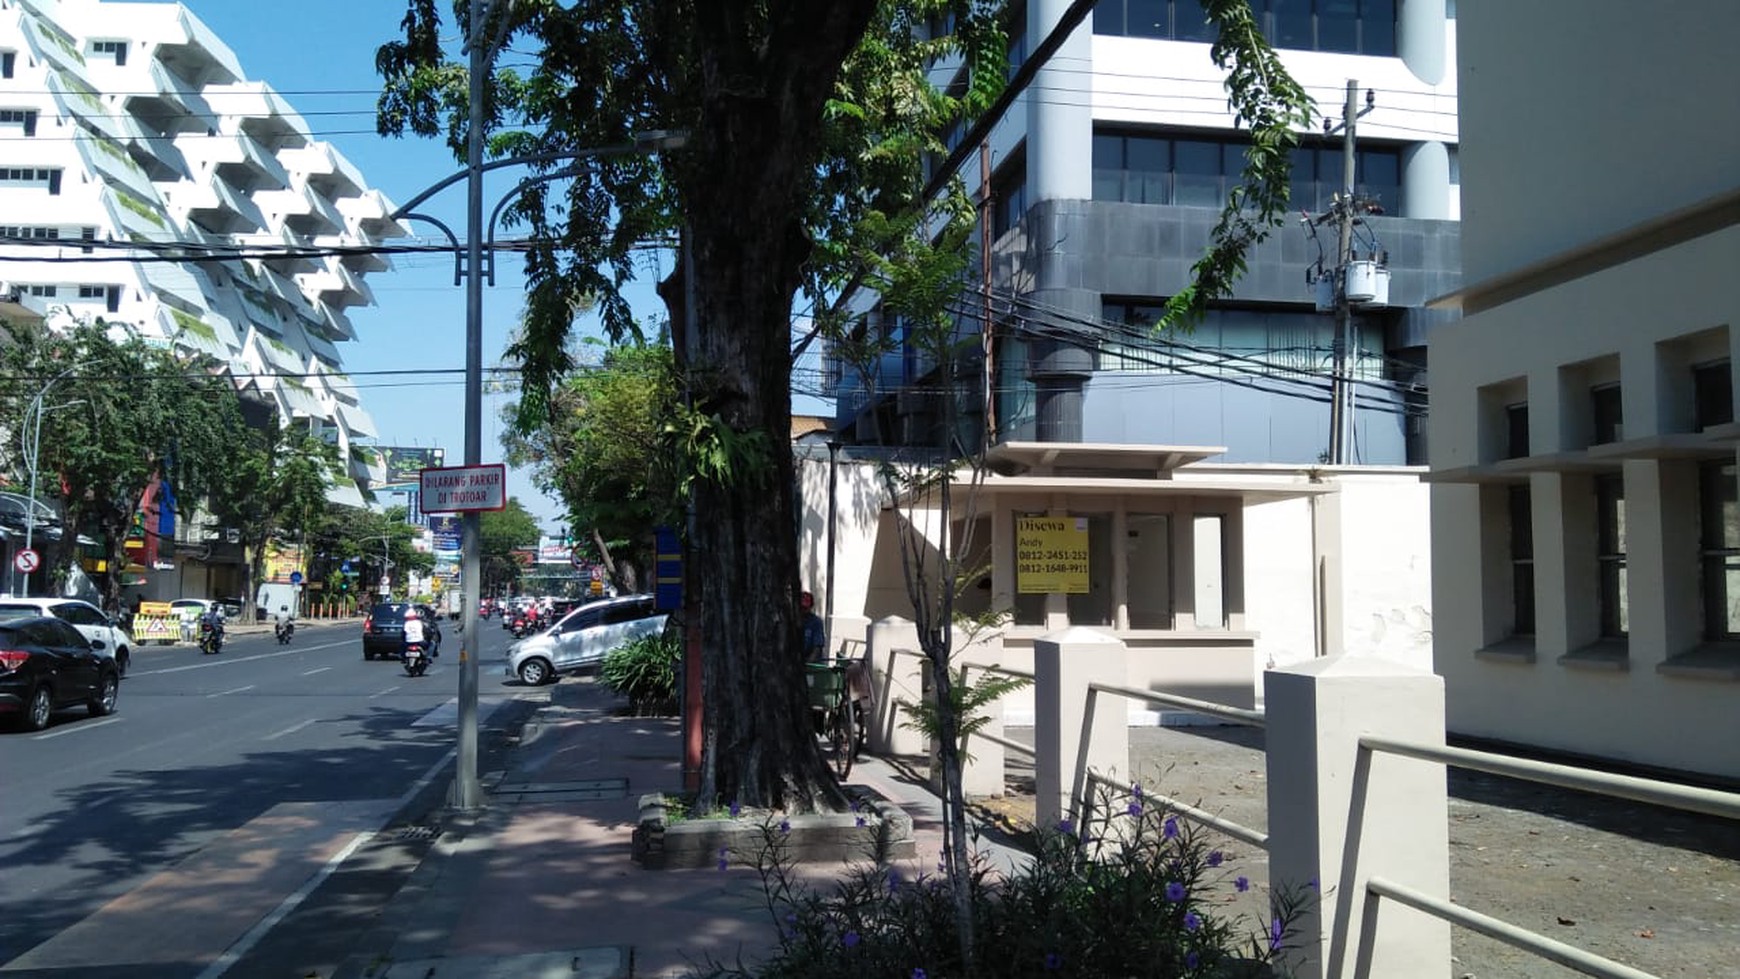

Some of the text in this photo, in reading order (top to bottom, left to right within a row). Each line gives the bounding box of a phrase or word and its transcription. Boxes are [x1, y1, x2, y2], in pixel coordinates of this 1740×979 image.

[424, 476, 466, 489] DILARANG
[469, 473, 500, 486] PARKIR
[437, 490, 487, 504] DI TROTOAR
[1019, 520, 1065, 531] Disewa
[1019, 538, 1043, 547] Andy
